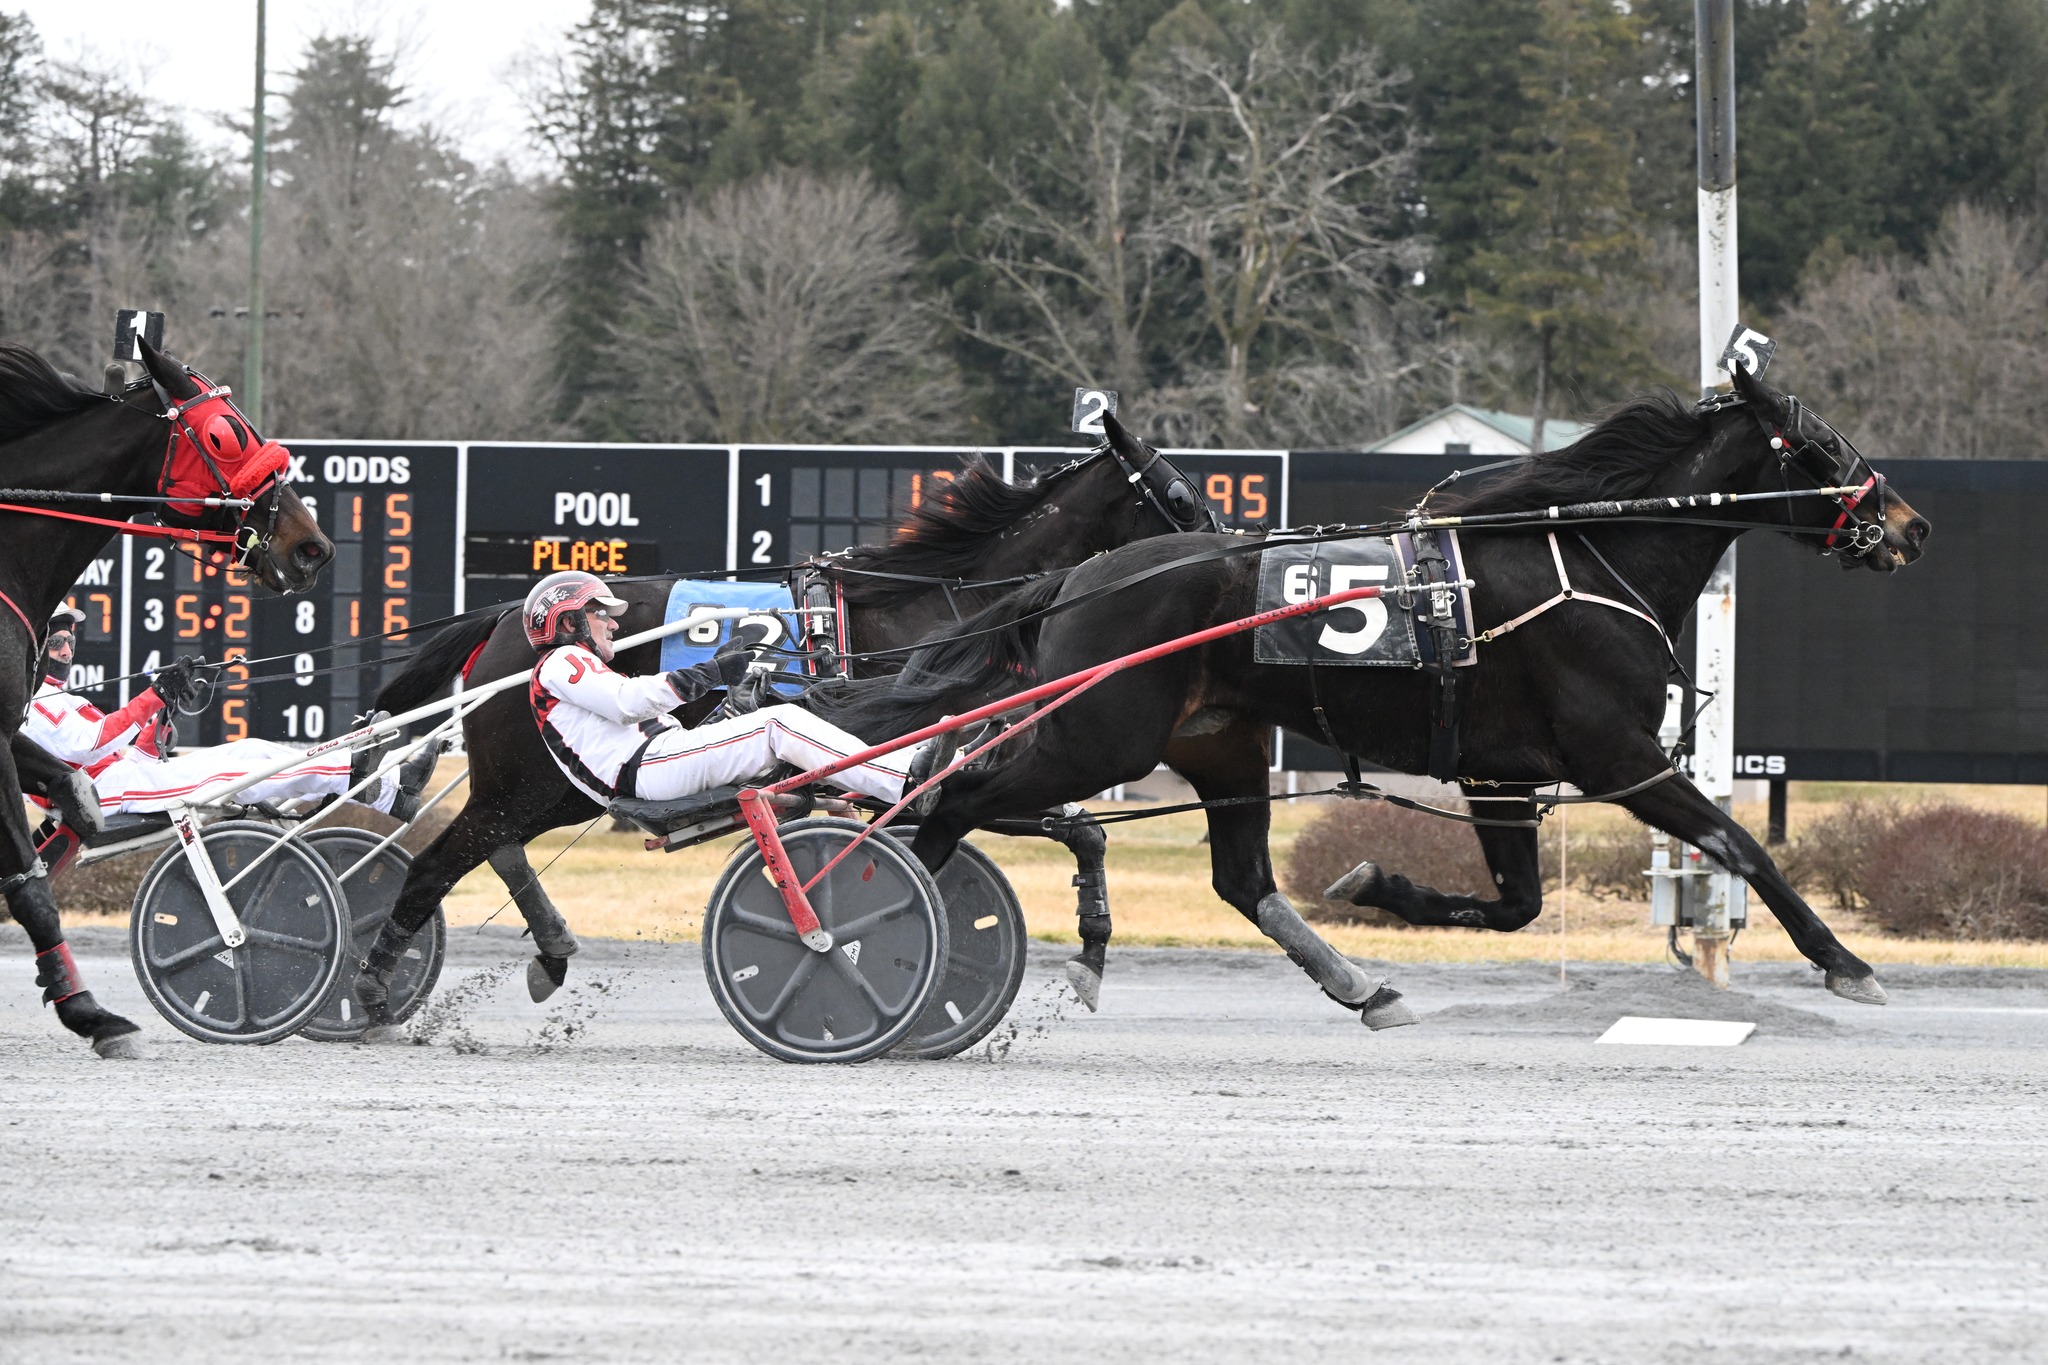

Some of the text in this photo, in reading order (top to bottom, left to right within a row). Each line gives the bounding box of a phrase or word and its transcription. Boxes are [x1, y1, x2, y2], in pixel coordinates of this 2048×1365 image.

[129, 310, 147, 361] 1
[1727, 327, 1770, 377] 5
[1078, 390, 1109, 434] 2
[323, 455, 411, 484] ODDS
[754, 473, 772, 507] 1
[1206, 473, 1268, 519] 95
[554, 491, 640, 527] POOL
[144, 547, 165, 580] 2
[532, 540, 628, 572] PLACE
[751, 530, 773, 564] 2
[384, 545, 411, 589] 2
[143, 598, 164, 632] 3
[294, 600, 316, 634] 8
[1282, 564, 1389, 655] 6 5
[61, 664, 105, 692] ON
[294, 652, 315, 686] 9
[282, 704, 325, 739] 10
